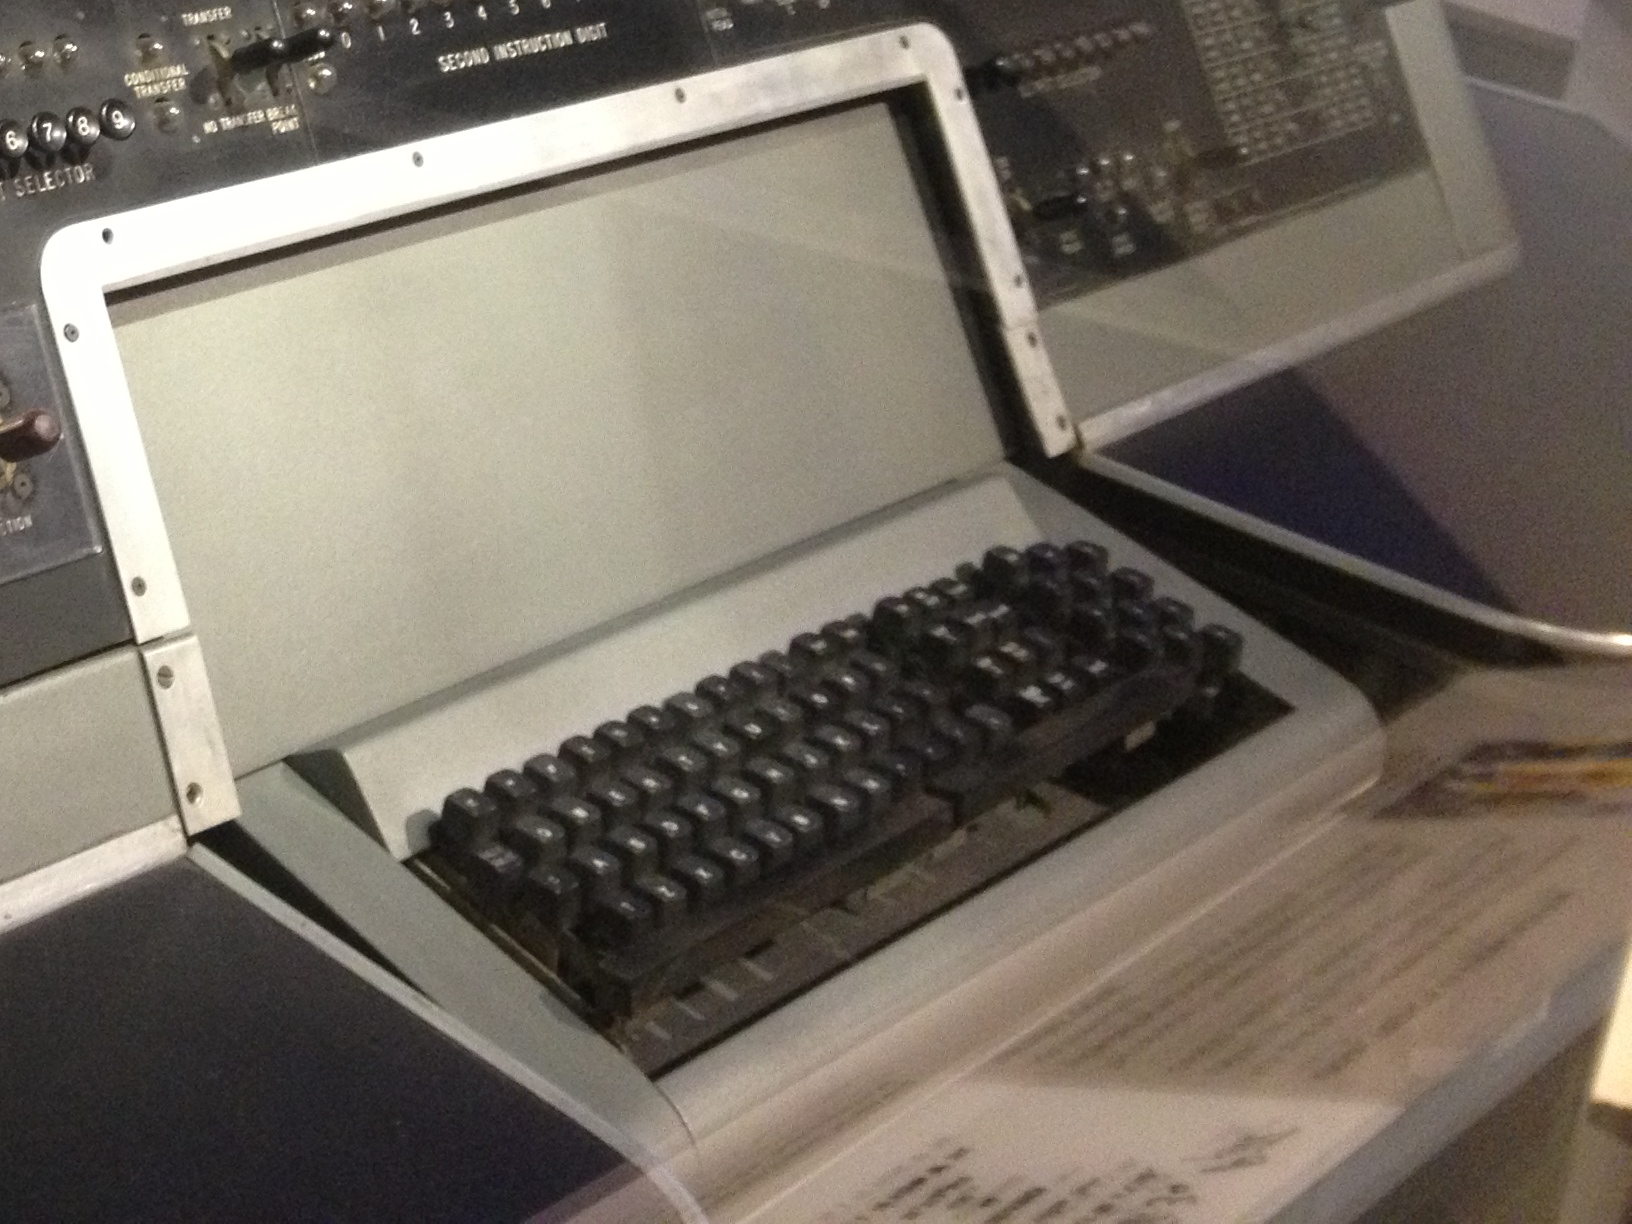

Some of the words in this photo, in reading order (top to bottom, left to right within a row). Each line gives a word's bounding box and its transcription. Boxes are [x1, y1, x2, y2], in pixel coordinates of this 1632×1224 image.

[181, 6, 232, 27] TRANSFER
[409, 18, 421, 36] 2
[443, 11, 455, 29] 3
[477, 5, 488, 21] 4
[437, 46, 490, 74] SECOND
[493, 30, 574, 62] INSTRUCTION
[5, 130, 19, 150] 6
[42, 122, 54, 143] 7
[77, 115, 91, 136] 8
[111, 109, 125, 130] 9
[13, 162, 96, 200] SELECTOR
